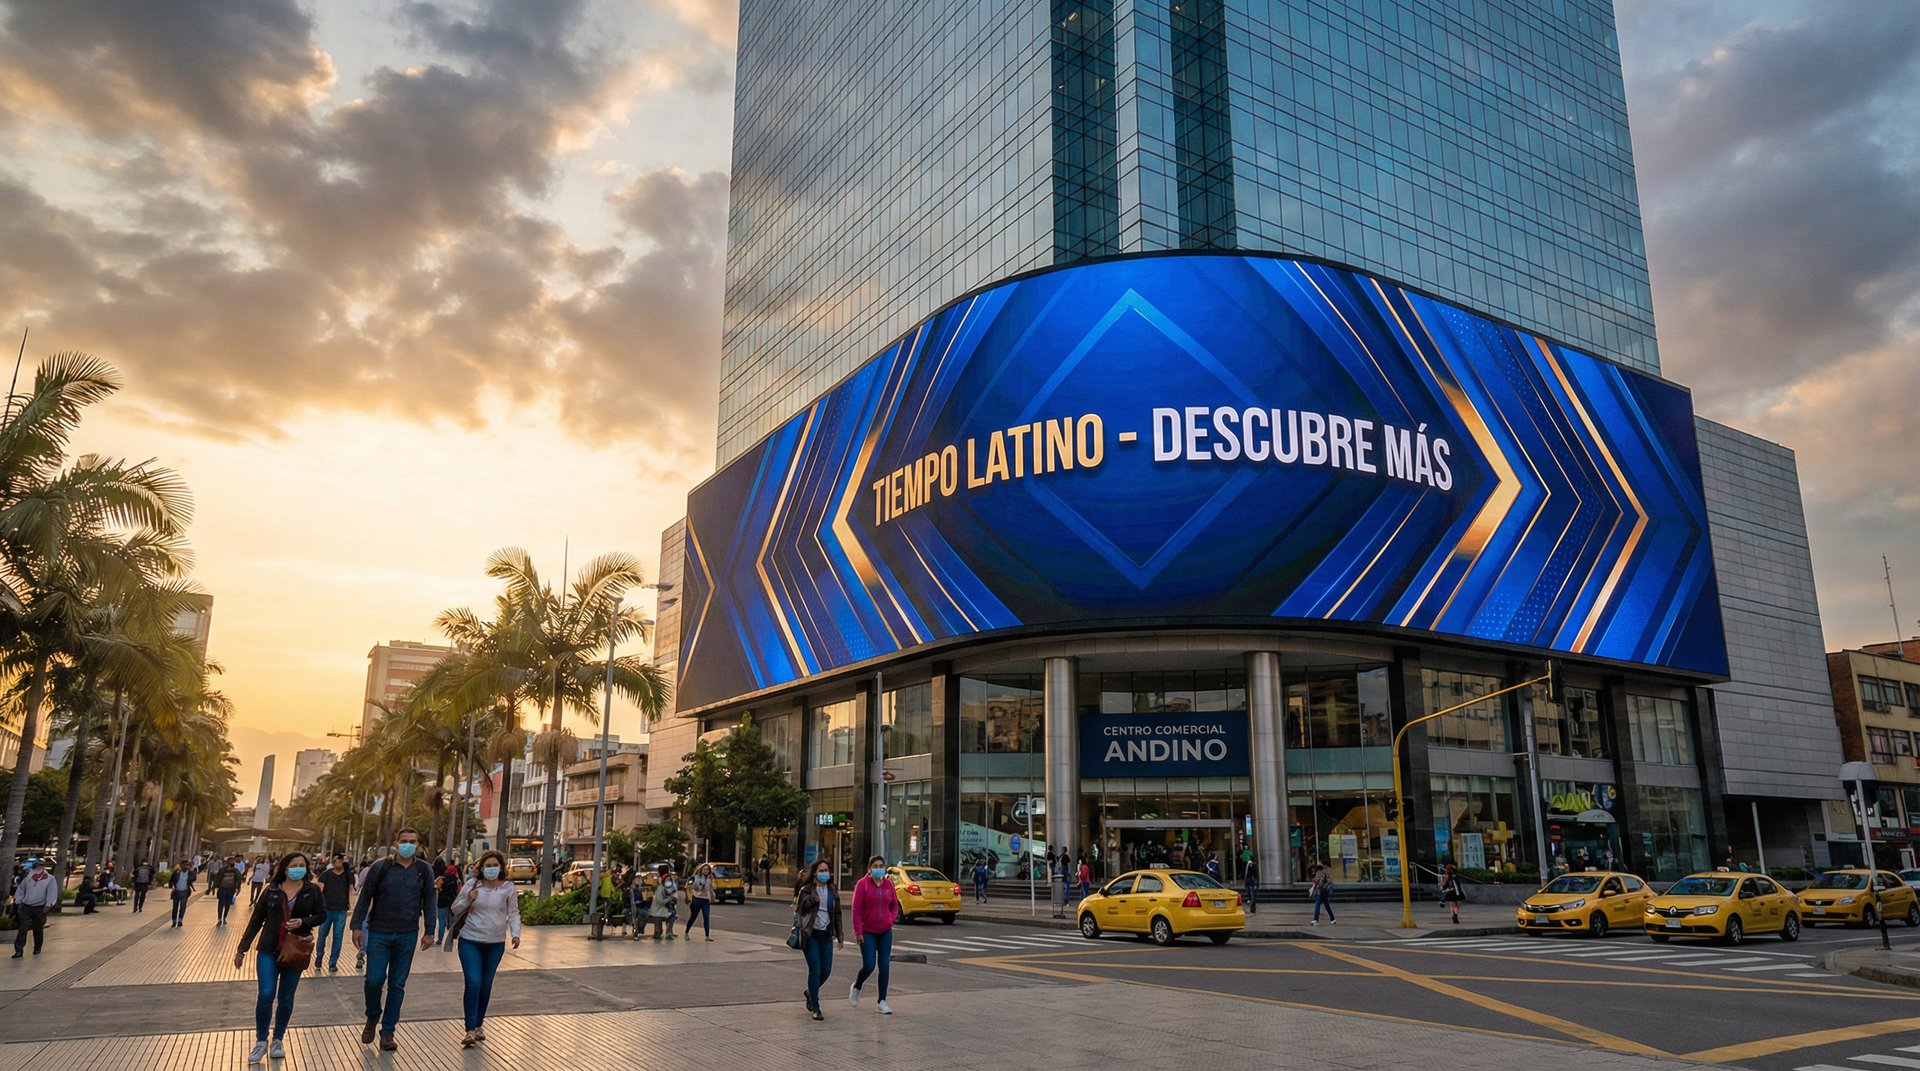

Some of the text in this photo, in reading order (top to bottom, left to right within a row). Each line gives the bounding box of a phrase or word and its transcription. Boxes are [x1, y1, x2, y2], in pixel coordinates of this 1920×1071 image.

[873, 406, 1454, 526] TIEMPO LATINO - DESCUBRE MÁS
[1104, 725, 1226, 736] CENTRO COMERCIAL
[1104, 739, 1227, 762] ANDINO
